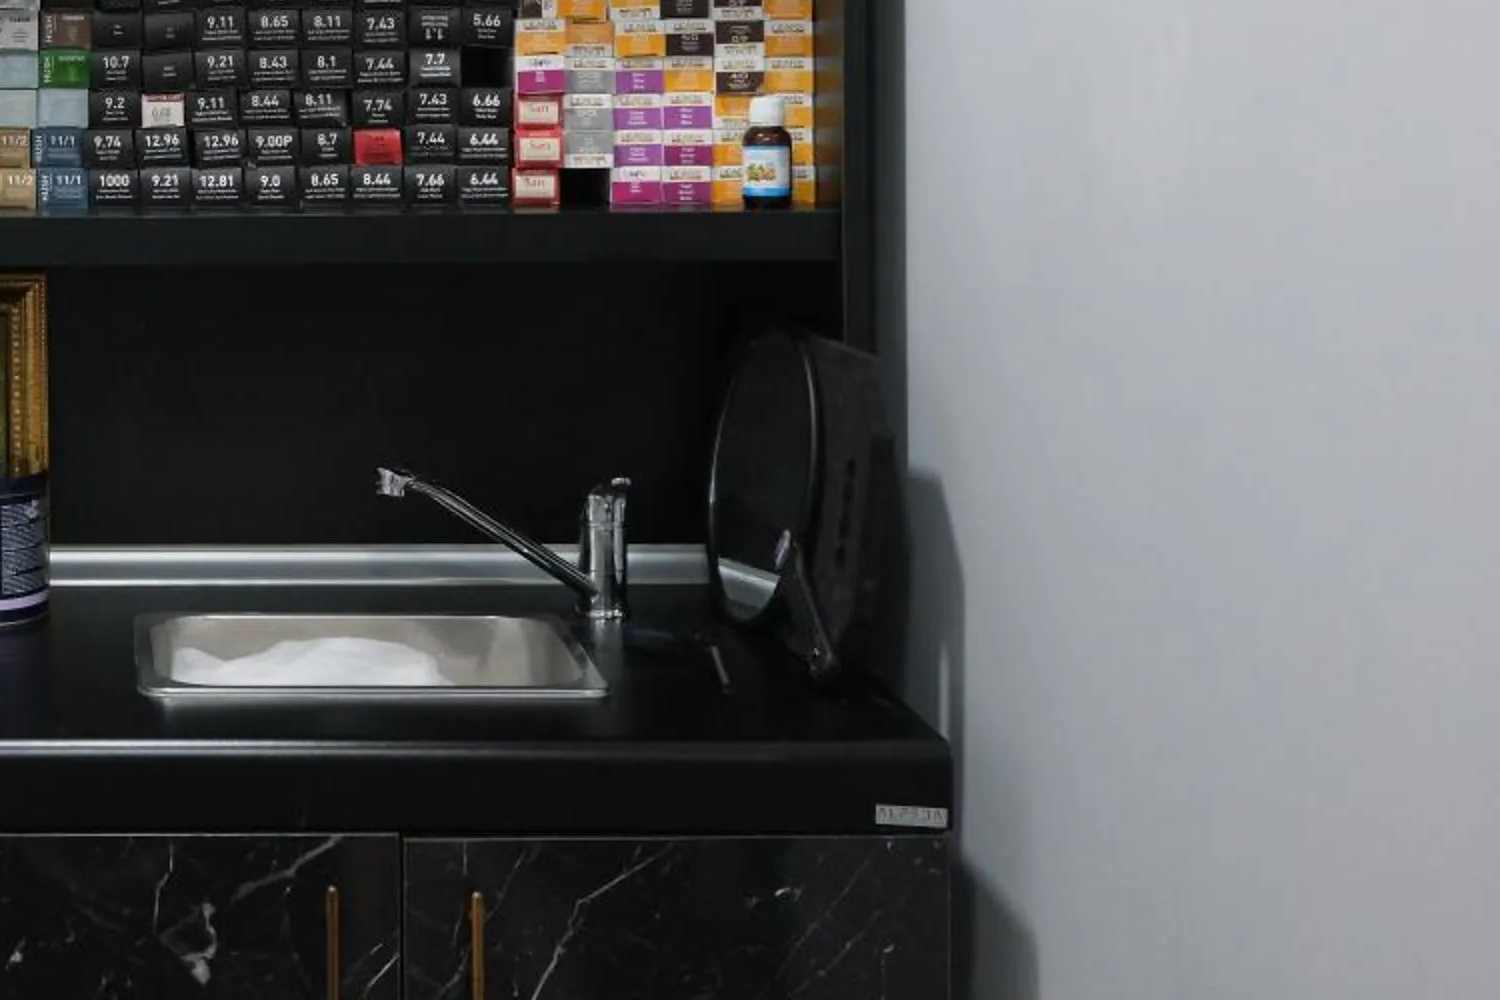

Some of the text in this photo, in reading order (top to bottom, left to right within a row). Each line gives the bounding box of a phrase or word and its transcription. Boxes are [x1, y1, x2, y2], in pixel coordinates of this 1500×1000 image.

[207, 15, 234, 29] 9.11
[313, 15, 341, 28] 8.11
[473, 13, 501, 27] 5.66
[103, 55, 130, 69] 10.7
[207, 55, 234, 68] 9.21
[317, 56, 336, 68] 8.1
[425, 53, 445, 66] 7.7
[105, 97, 125, 109] 9.2
[197, 96, 225, 110] 9.11
[305, 94, 332, 105] 8.11
[363, 99, 392, 111] 7.74
[419, 93, 447, 105] 7.43
[473, 93, 501, 106] 6.66
[145, 133, 180, 147] 12.96
[203, 133, 239, 147] 12.96
[317, 133, 337, 145] 8.7
[417, 131, 445, 144] 7.44
[56, 174, 81, 185] 11/1
[151, 174, 179, 187] 9.21
[200, 174, 234, 187] 12.81
[260, 174, 281, 187] 9.0
[311, 173, 339, 187] 8.65
[363, 173, 391, 185] 8.44
[416, 173, 445, 186] 7.66
